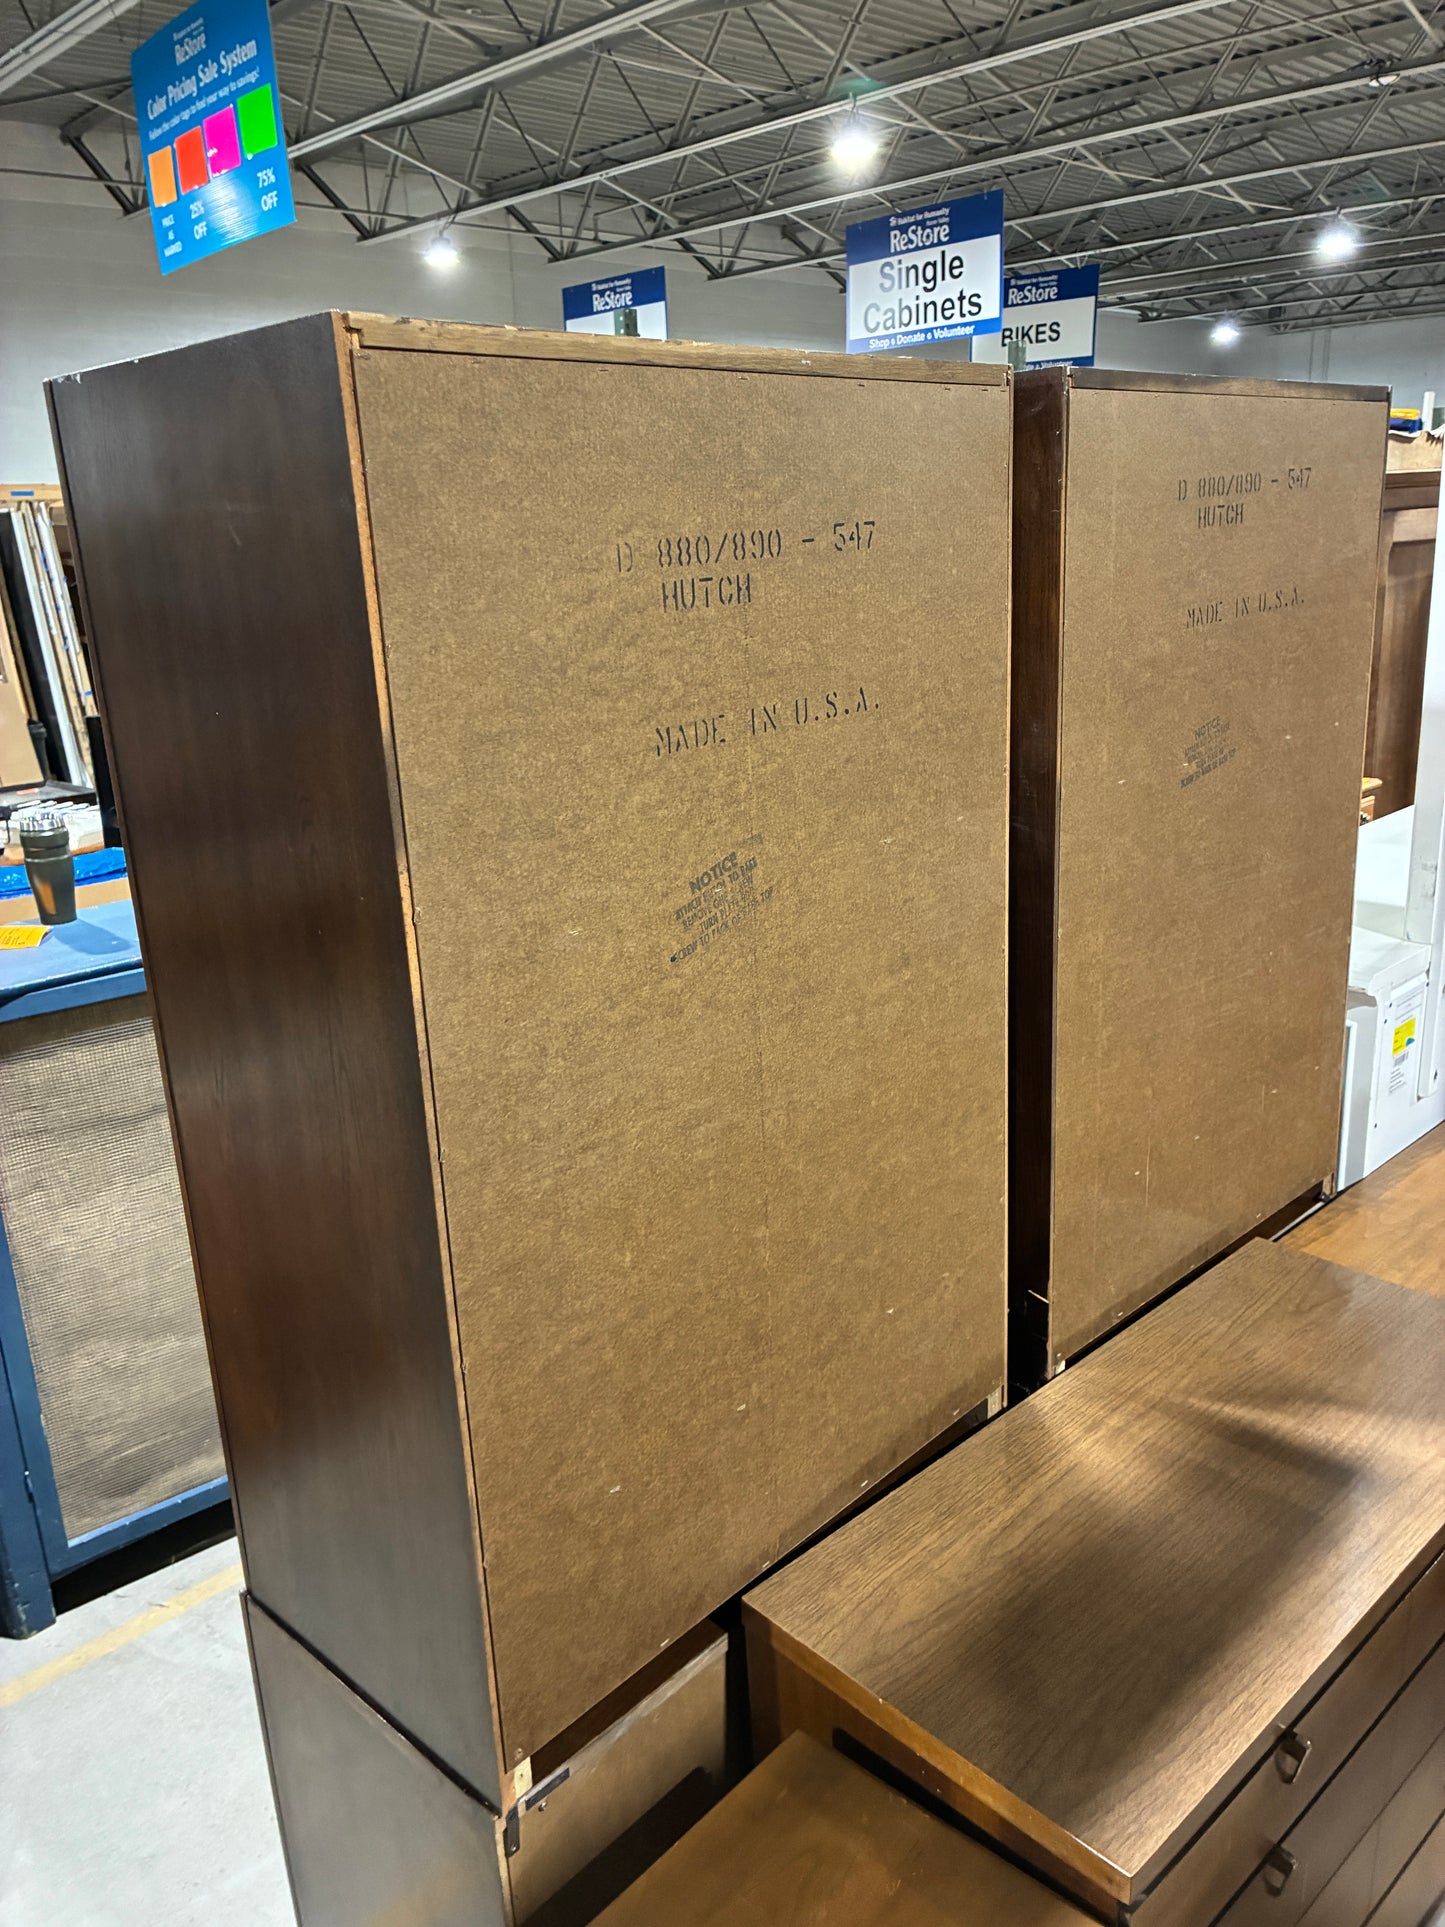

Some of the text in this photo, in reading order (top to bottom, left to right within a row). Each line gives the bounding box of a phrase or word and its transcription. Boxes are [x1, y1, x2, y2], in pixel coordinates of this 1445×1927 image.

[175, 32, 206, 66] ReStore
[147, 39, 257, 120] Color Pricing Sale System
[257, 166, 276, 188] 75%
[189, 200, 205, 219] 25%
[261, 190, 278, 211] OFF
[898, 215, 915, 225] Habitat
[924, 207, 950, 219] Humanity
[193, 221, 207, 240] OFF
[889, 224, 950, 253] ReStore
[879, 249, 964, 293] Single
[592, 290, 633, 313] ReStore
[1007, 285, 1058, 306] ReStore
[863, 288, 982, 333] Cabinets
[869, 325, 975, 349] Shop Donate Volunteer
[1001, 321, 1061, 347] BIKES
[1178, 479, 1188, 501] D
[1198, 472, 1262, 498] 880/890
[1288, 467, 1312, 490] 547
[1198, 503, 1244, 529] HUTCH
[616, 542, 633, 573] D
[657, 529, 781, 568] 880/890
[833, 520, 876, 551] 547
[661, 573, 751, 613] HUTCH
[1186, 587, 1305, 629] MADE IN U.S.A.
[655, 687, 879, 756] MADE IN U.S.A.
[689, 851, 738, 894] NOTICE
[700, 933, 709, 946] TO
